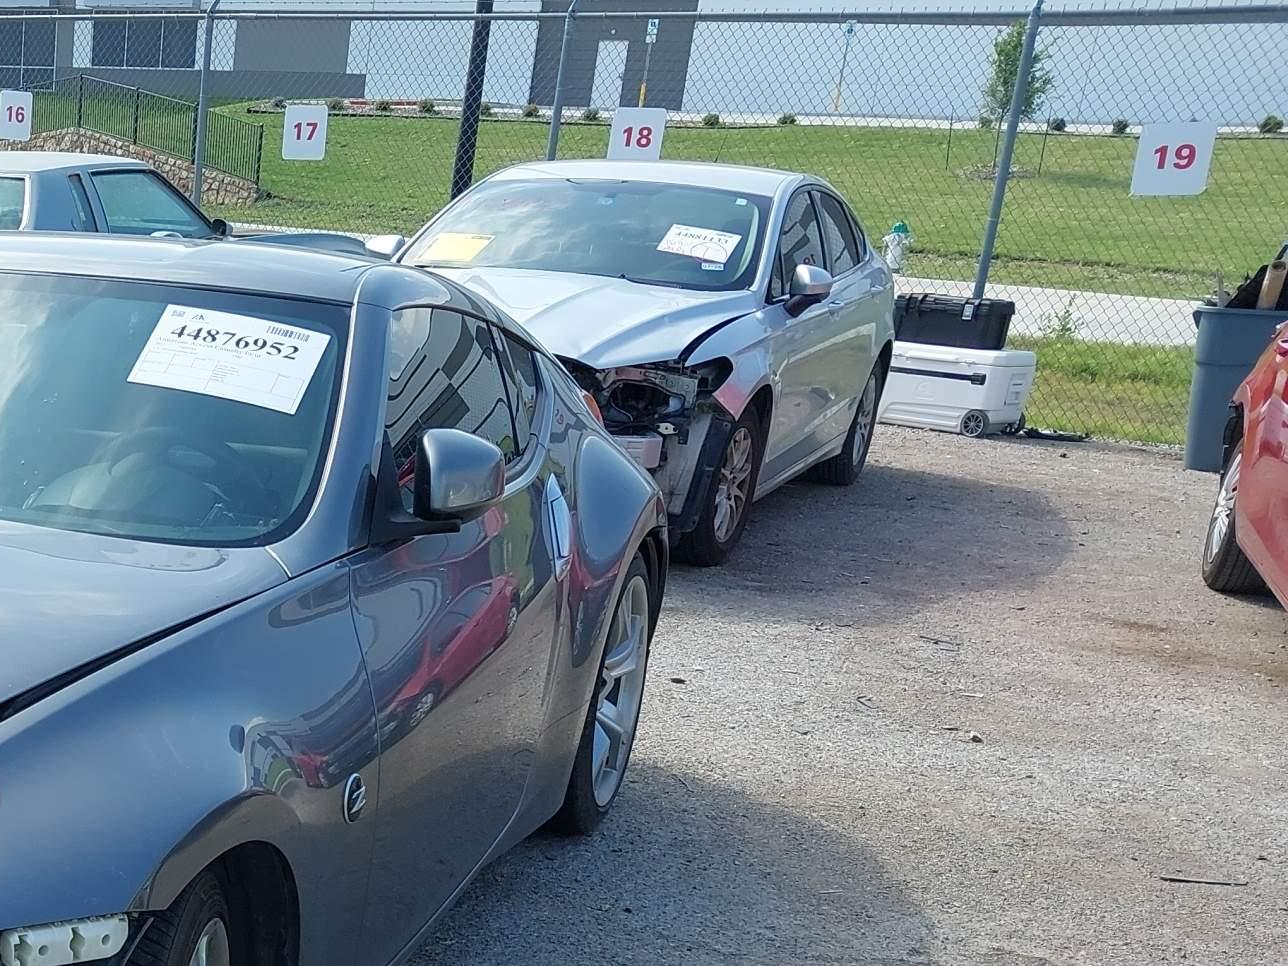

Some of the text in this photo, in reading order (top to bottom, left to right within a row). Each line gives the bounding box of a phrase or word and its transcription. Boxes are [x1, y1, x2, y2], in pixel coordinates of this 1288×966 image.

[6, 105, 25, 124] 16
[294, 122, 318, 141] 17
[623, 126, 653, 148] 18
[1153, 143, 1197, 170] 19
[170, 323, 300, 361] 44876952
